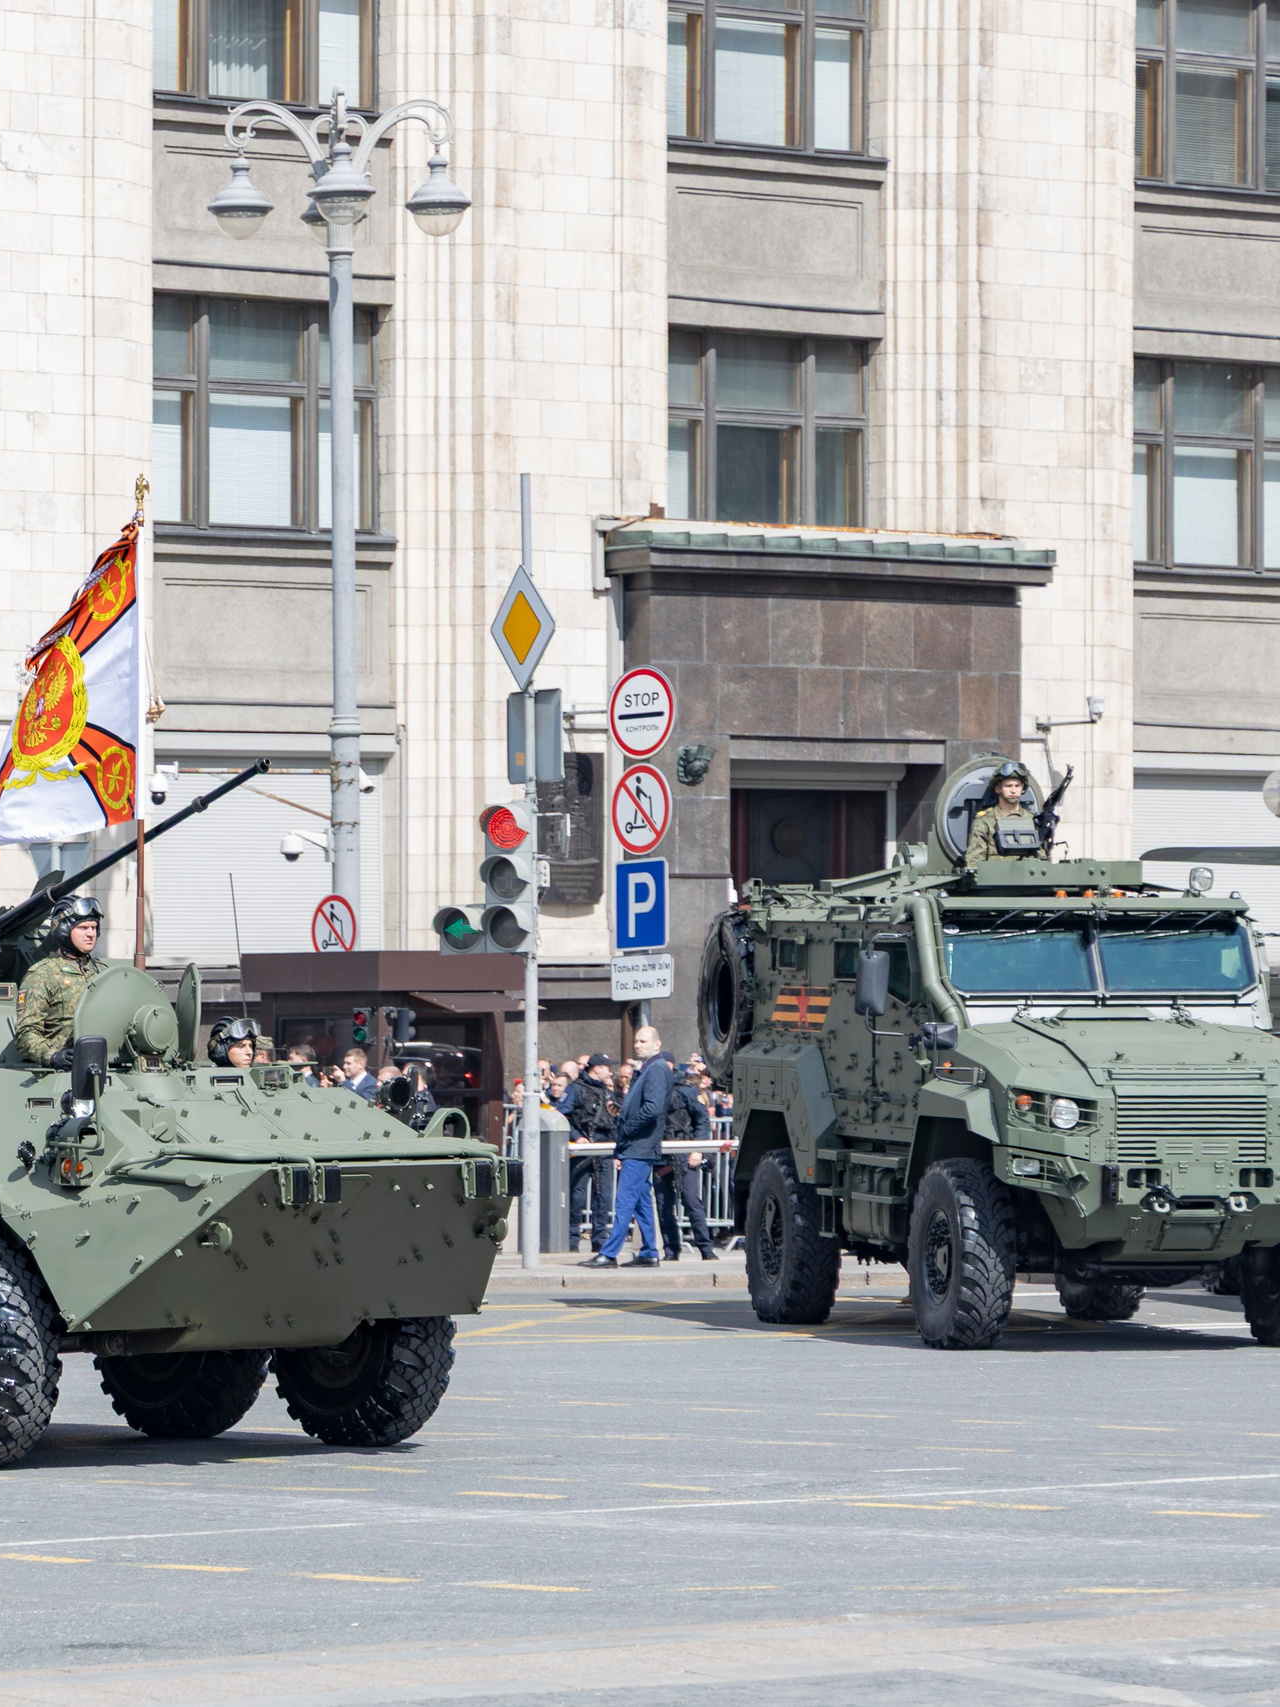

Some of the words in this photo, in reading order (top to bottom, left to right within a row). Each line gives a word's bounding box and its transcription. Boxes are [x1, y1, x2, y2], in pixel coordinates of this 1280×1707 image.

[624, 692, 659, 708] STOP
[625, 724, 659, 733] КОНТРОЛЬ
[628, 872, 656, 938] P
[613, 964, 640, 973] Только
[642, 963, 656, 973] для
[658, 961, 671, 970] а/м
[615, 981, 631, 990] Гос.
[633, 980, 655, 991] Думы
[656, 978, 668, 987] РФ
